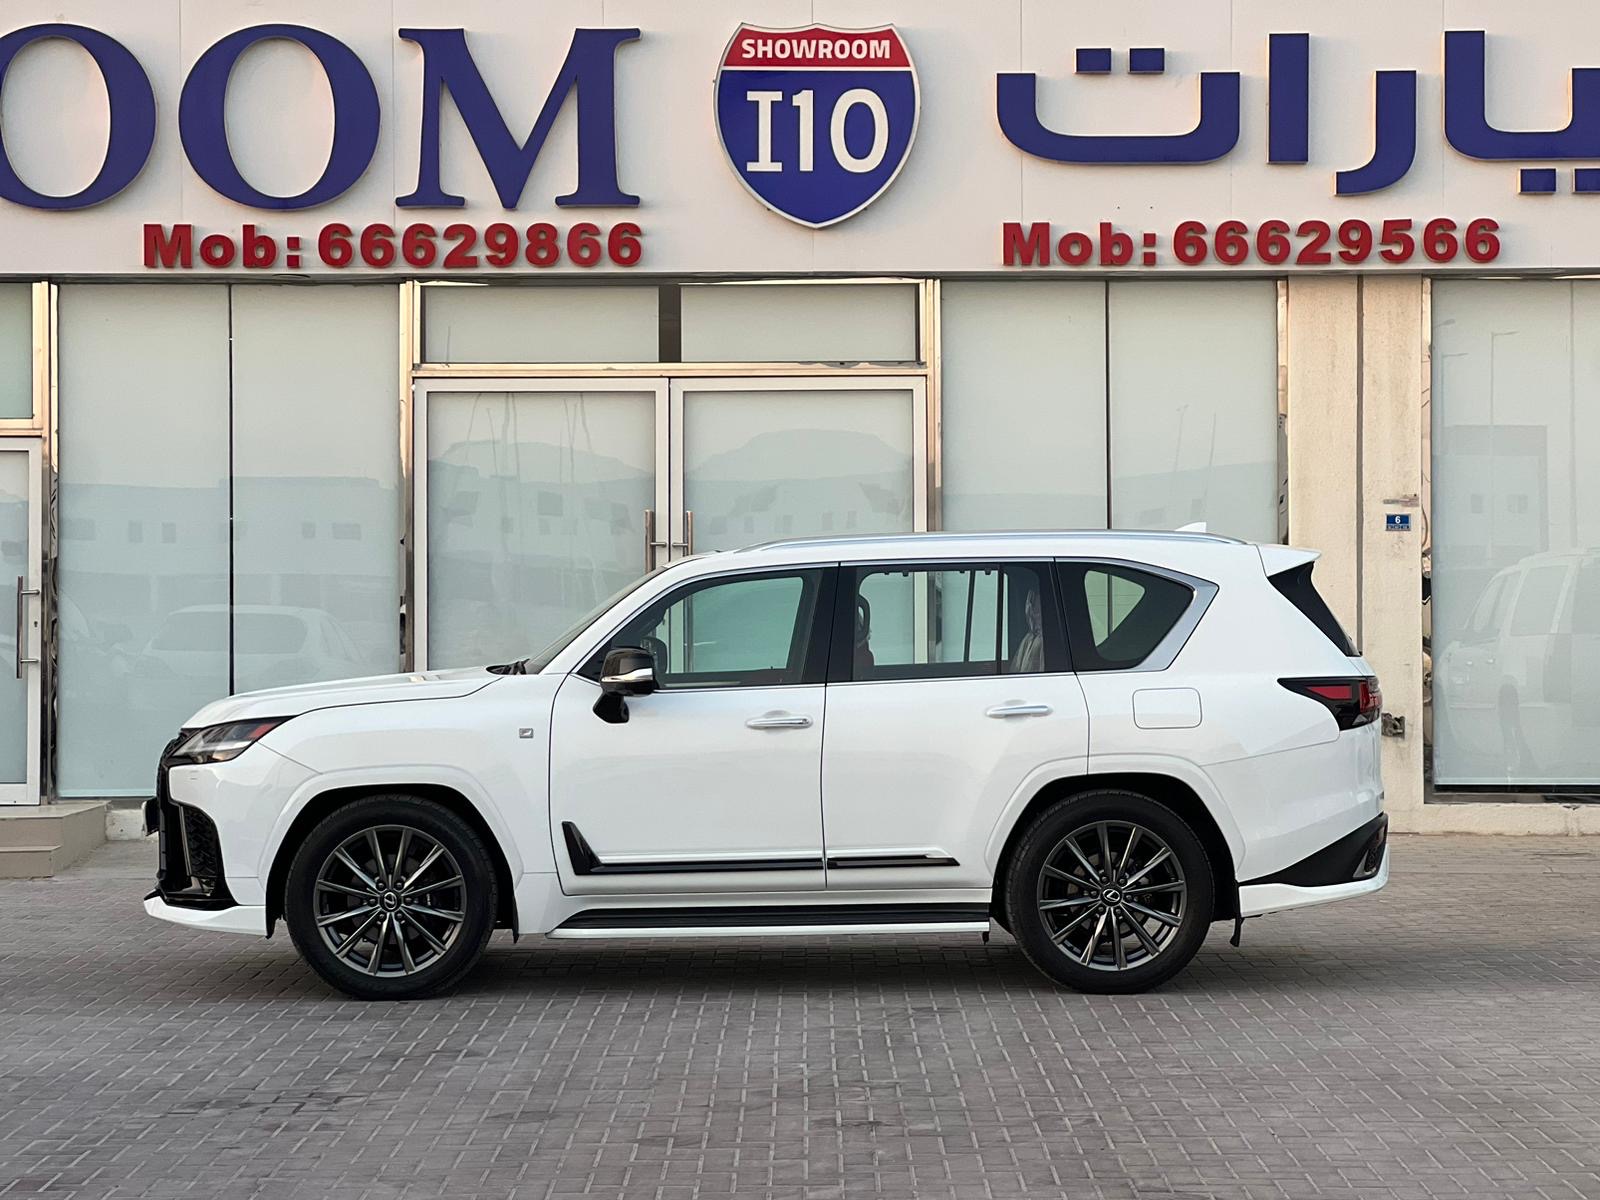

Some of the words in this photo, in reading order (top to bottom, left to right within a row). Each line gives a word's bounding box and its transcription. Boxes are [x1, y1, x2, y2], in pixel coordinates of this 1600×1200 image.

[741, 38, 891, 60] SHOWROOM
[746, 88, 889, 174] I10
[143, 223, 303, 269] Mob:
[317, 222, 643, 269] 66629866
[1002, 221, 1158, 266] Mob:
[1172, 218, 1502, 265] 66629566
[1395, 515, 1401, 524] 6
